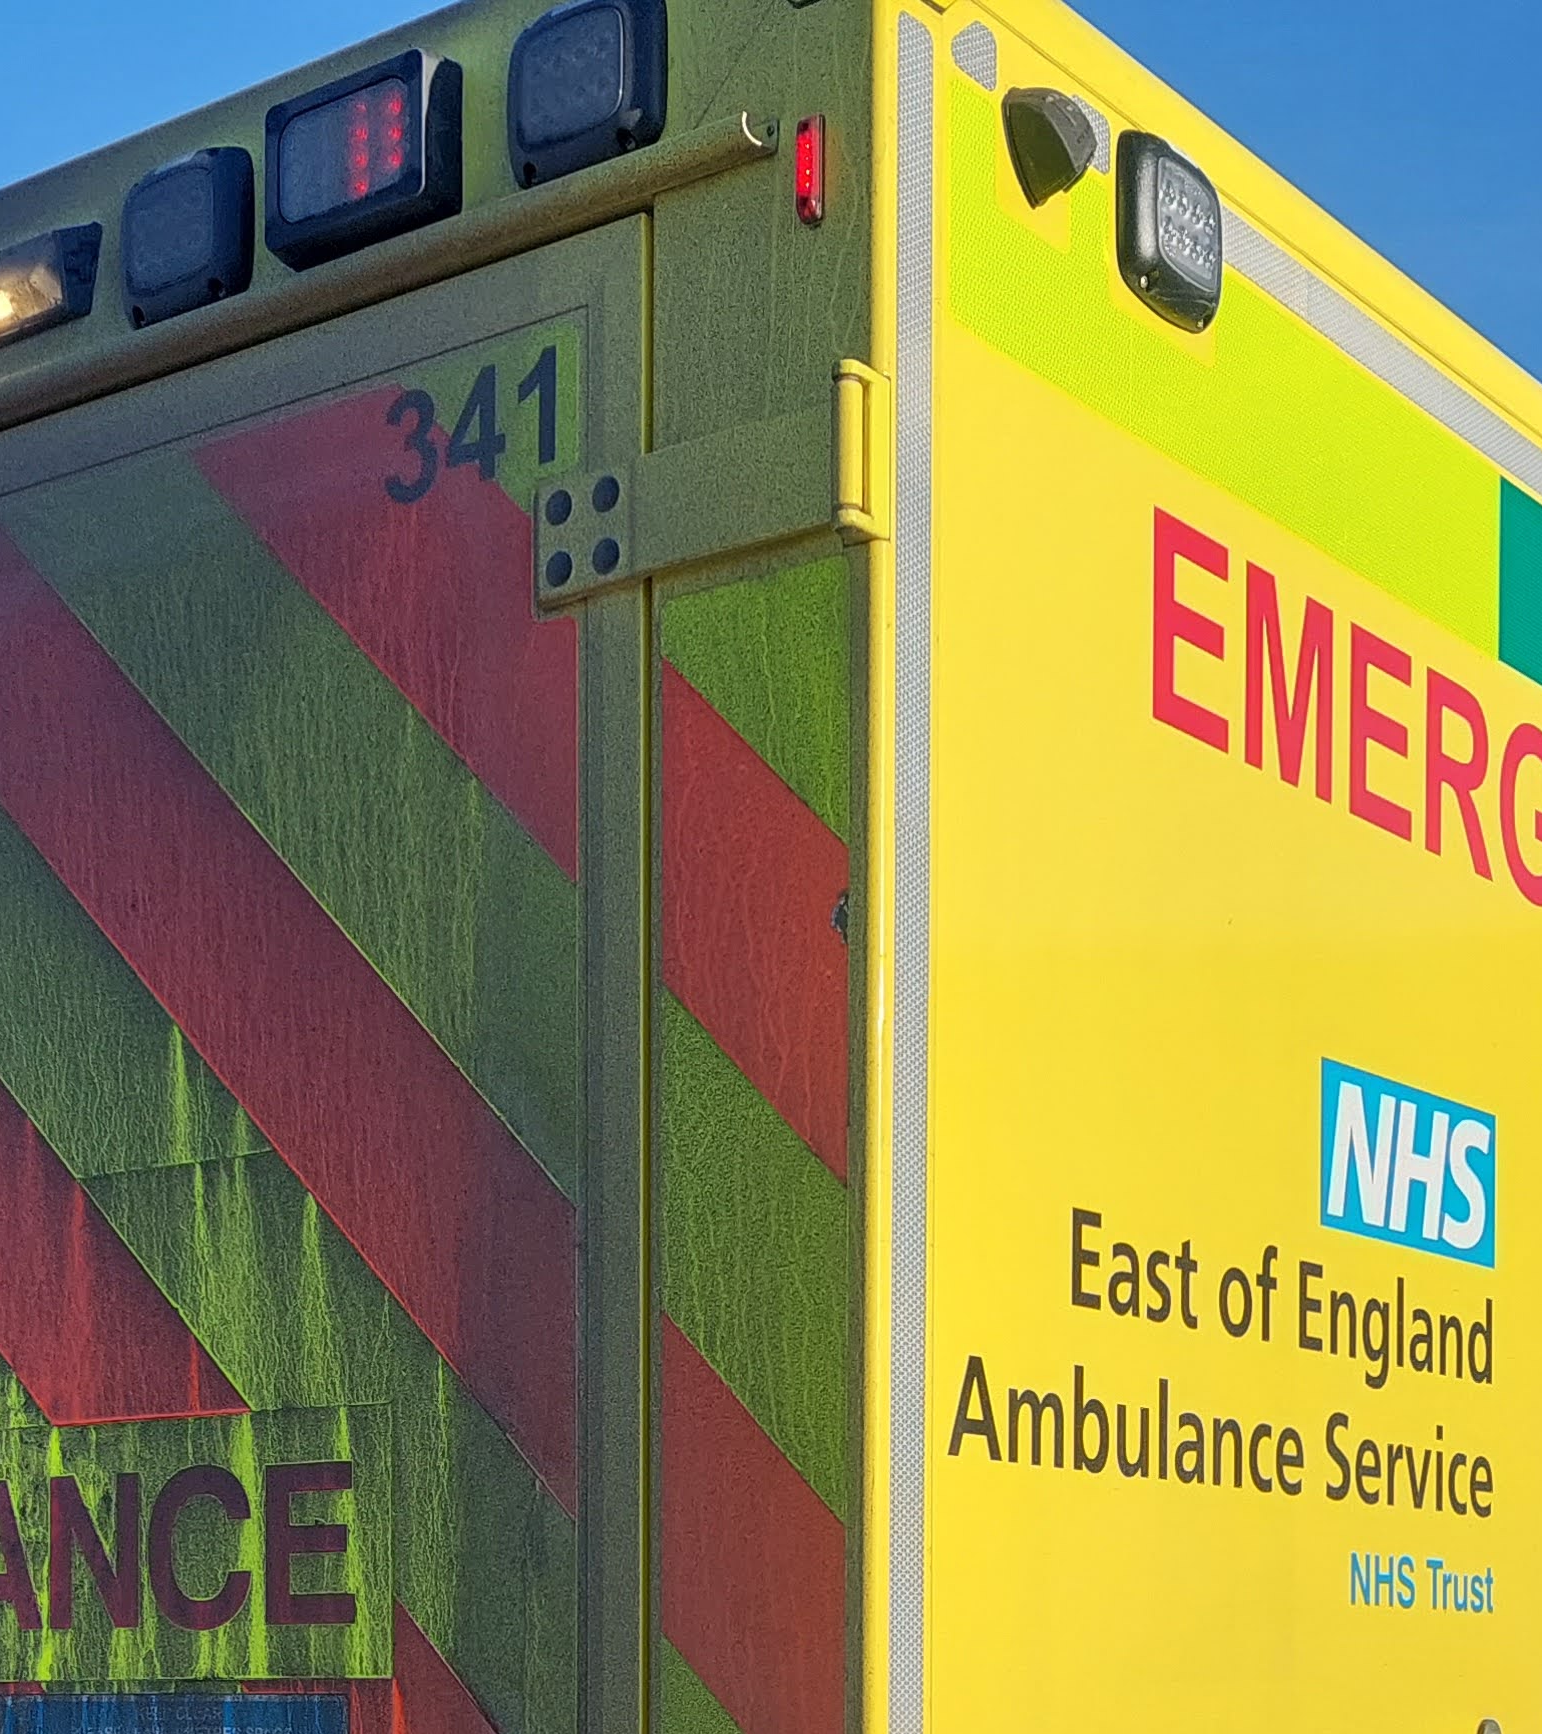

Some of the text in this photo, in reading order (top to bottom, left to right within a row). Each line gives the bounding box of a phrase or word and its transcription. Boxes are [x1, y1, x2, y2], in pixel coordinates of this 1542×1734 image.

[384, 345, 557, 505] 341
[1325, 1079, 1492, 1250] NHS
[1070, 1206, 1494, 1390] East of England
[947, 1354, 1494, 1519] Ambulance Service
[1349, 1552, 1495, 1614] NHS Trust
